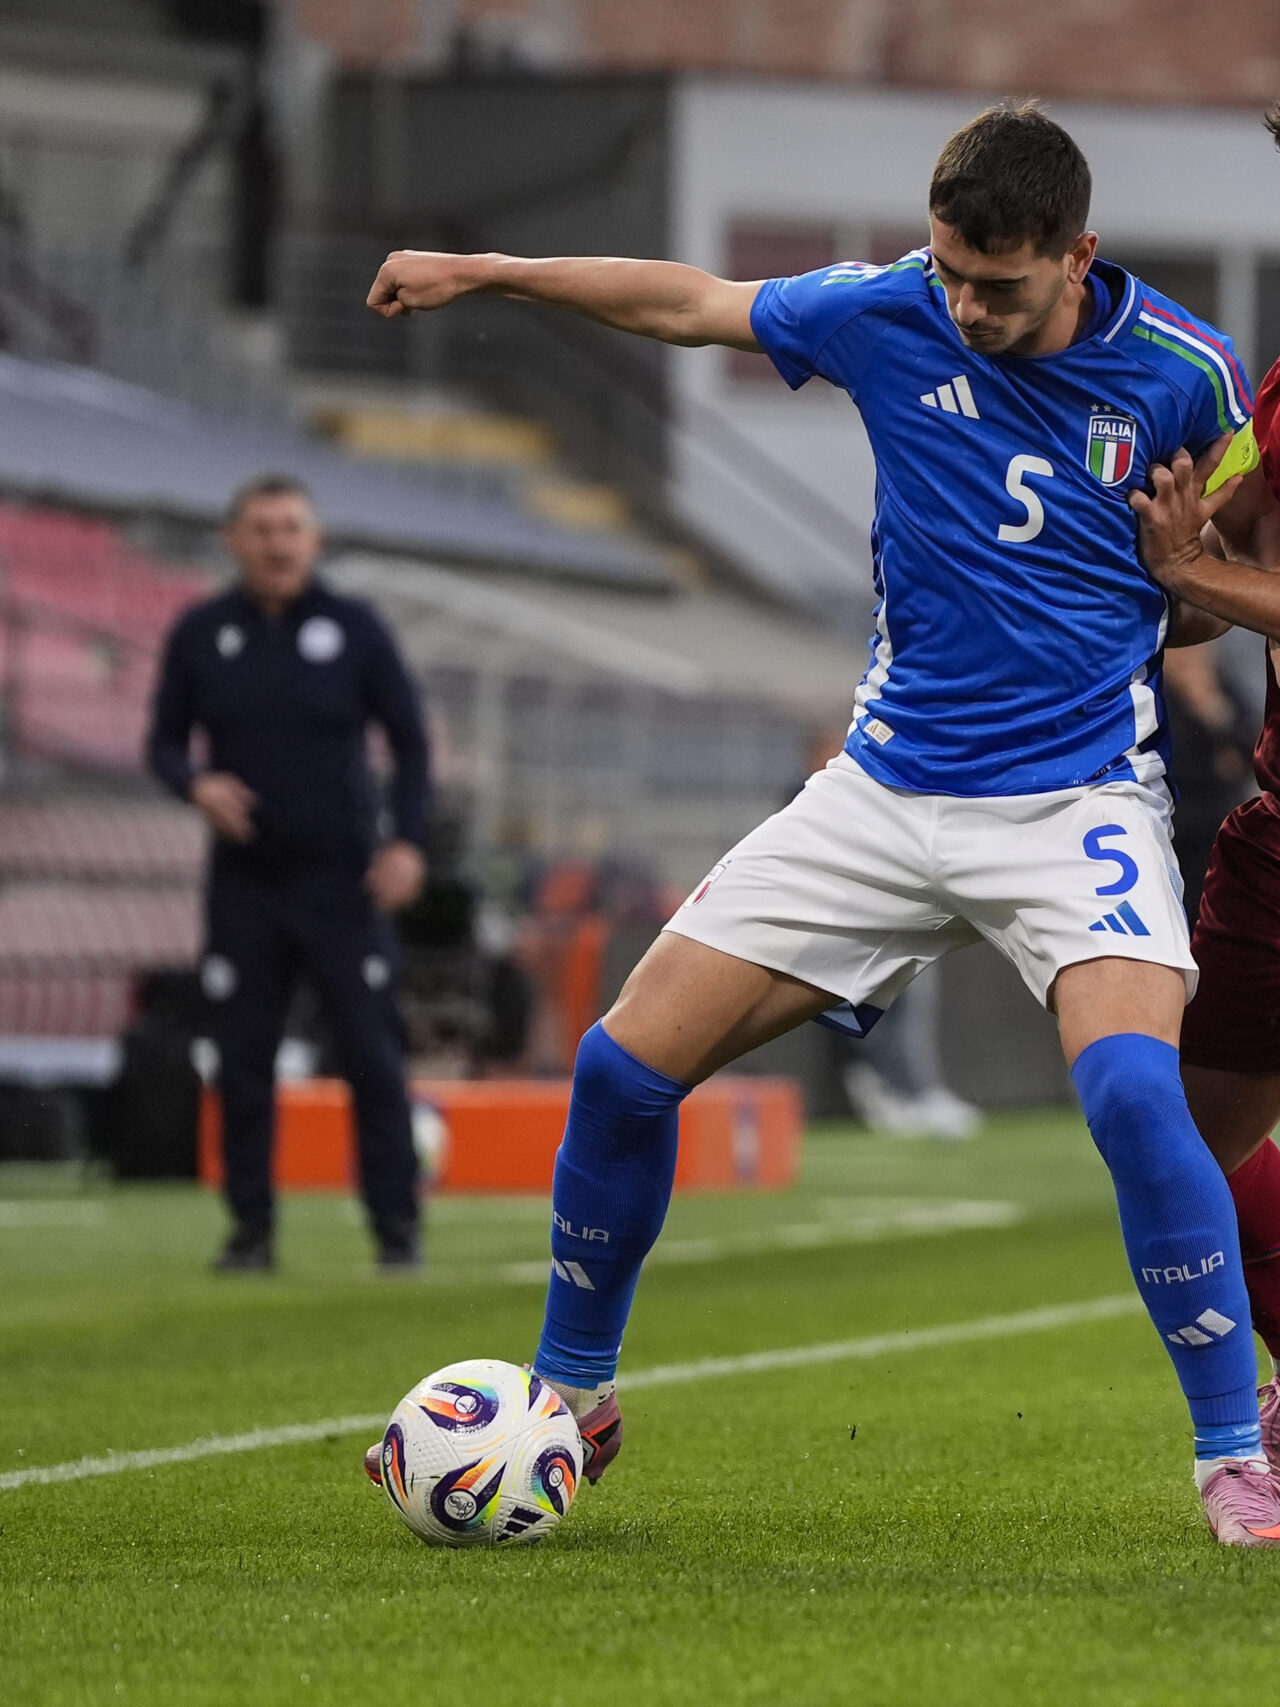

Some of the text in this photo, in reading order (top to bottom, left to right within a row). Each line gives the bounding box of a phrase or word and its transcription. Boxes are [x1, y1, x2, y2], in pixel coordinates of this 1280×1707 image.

[1093, 420, 1131, 437] ITALIA
[997, 454, 1054, 542] 5
[1083, 824, 1139, 896] 5
[1141, 1250, 1225, 1284] ITALIA
